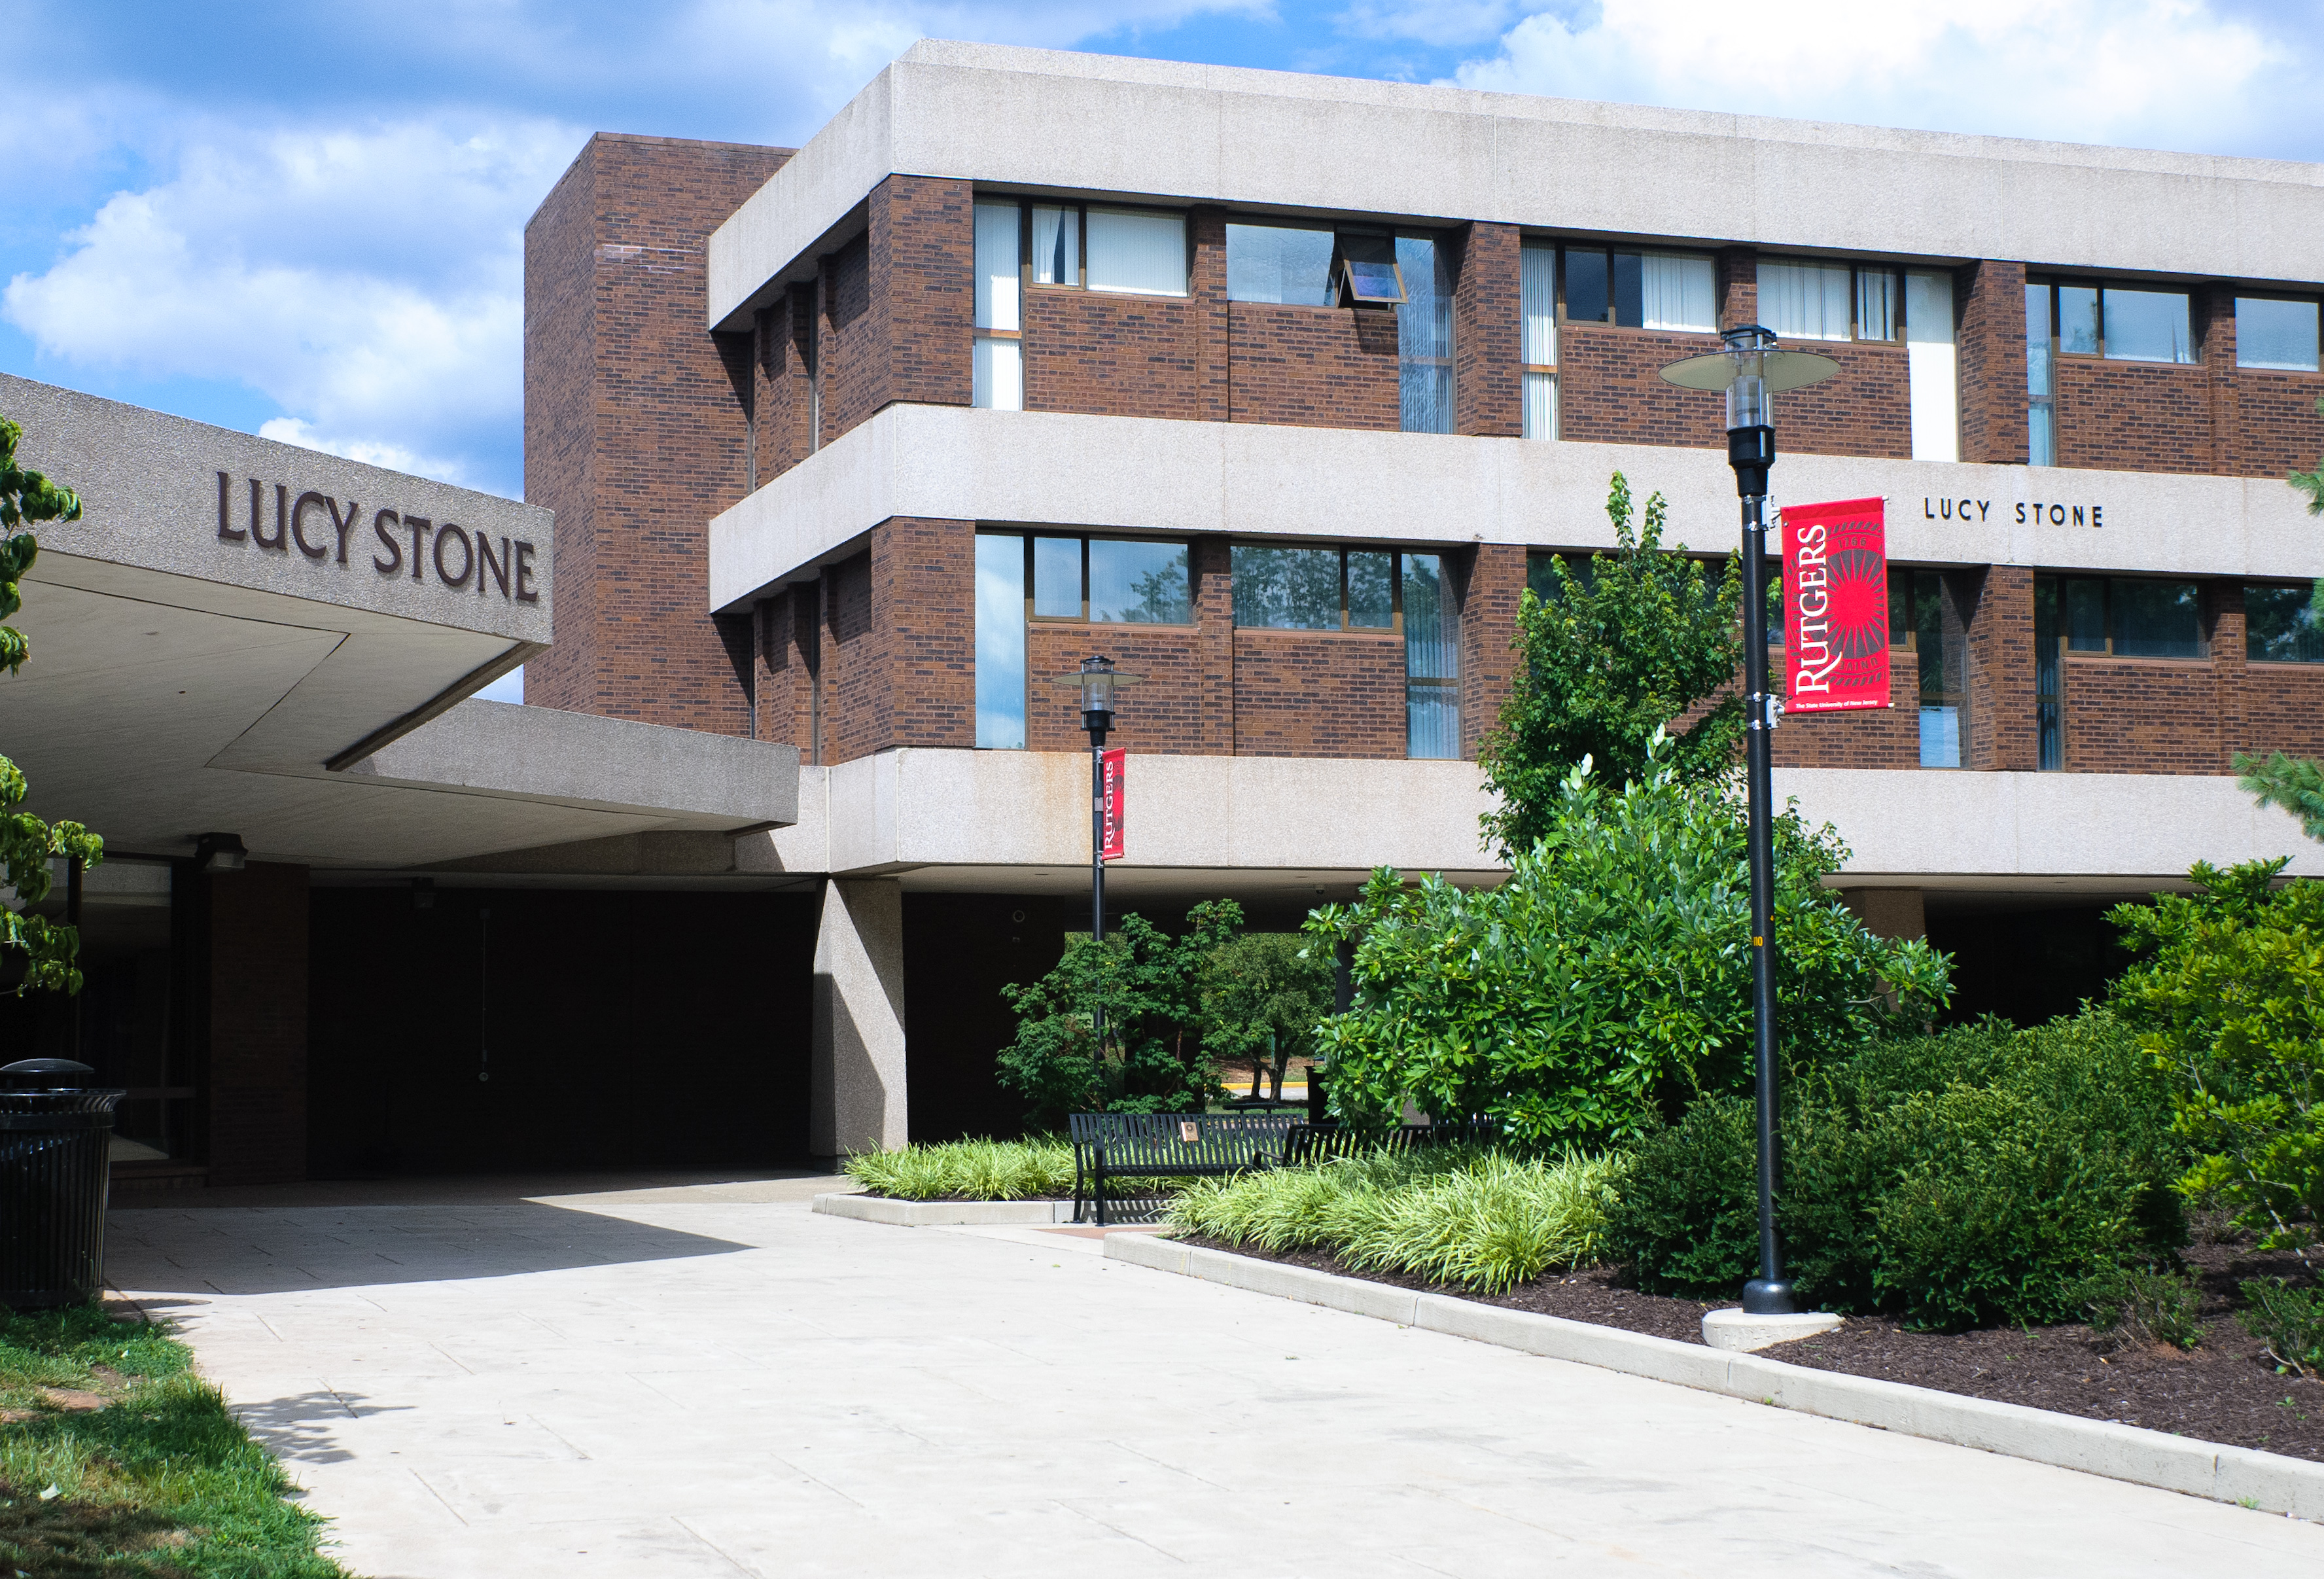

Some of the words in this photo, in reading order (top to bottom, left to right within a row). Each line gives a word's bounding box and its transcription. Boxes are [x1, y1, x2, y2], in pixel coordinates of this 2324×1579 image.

[217, 471, 359, 563] LUCY
[373, 508, 538, 602] STONE
[1924, 497, 1990, 522] LUCY
[2015, 502, 2103, 528] STONE
[1795, 524, 1842, 696] RUTGERS
[1104, 760, 1116, 849] RUTGERS
